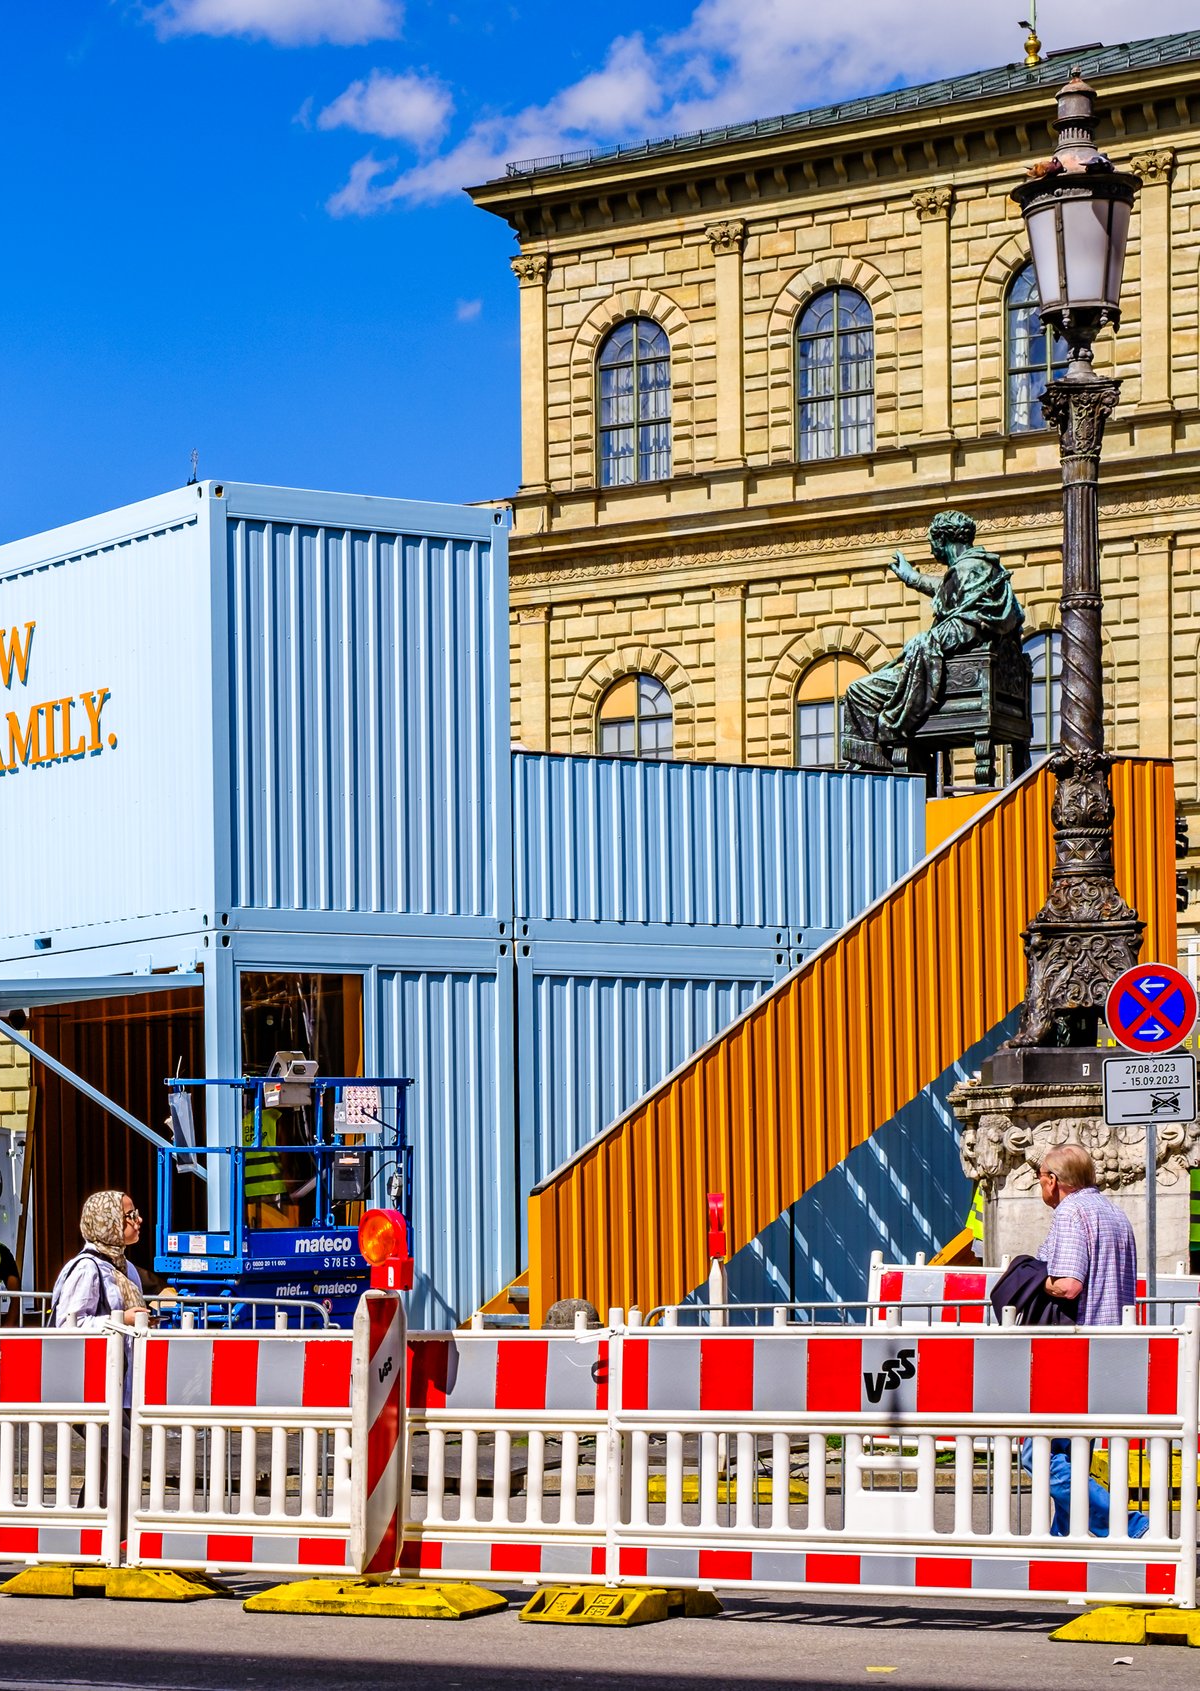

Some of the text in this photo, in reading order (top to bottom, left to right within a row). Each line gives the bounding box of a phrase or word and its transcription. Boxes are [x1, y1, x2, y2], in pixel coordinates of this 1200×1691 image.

[1083, 1065, 1089, 1074] 7
[1125, 1063, 1176, 1074] 27.08.2023
[1130, 1075, 1180, 1086] 15.09.2023
[294, 1235, 352, 1253] mateco
[323, 1258, 330, 1268] S
[331, 1258, 341, 1267] 78
[342, 1257, 349, 1267] E
[350, 1257, 356, 1266] S
[275, 1282, 358, 1296] miet... mateco
[378, 1356, 393, 1383] VSS
[863, 1348, 916, 1404] VSS
